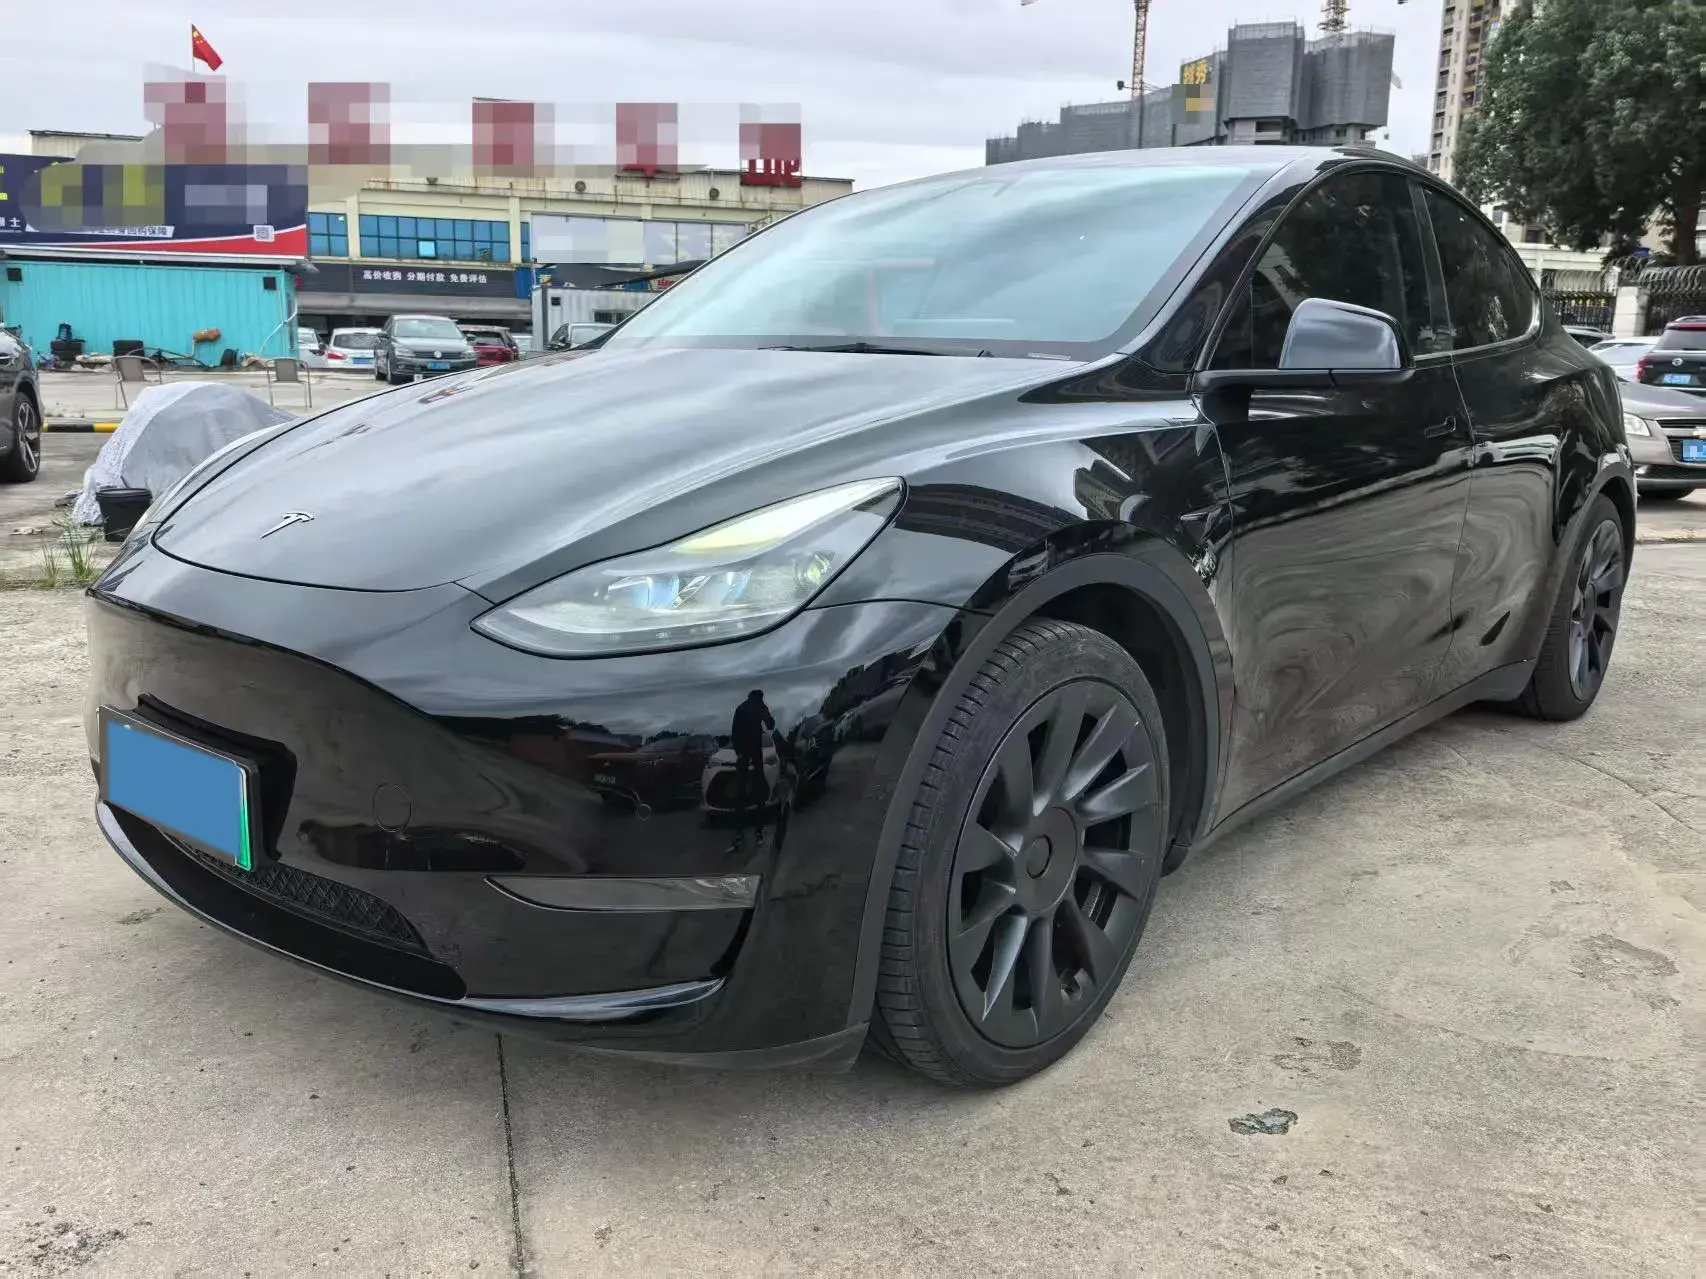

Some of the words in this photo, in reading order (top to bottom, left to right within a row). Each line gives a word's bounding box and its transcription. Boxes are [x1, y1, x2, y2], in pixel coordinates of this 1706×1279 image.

[363, 270, 402, 280] 高价收购
[406, 271, 445, 282] 分期付款
[449, 273, 488, 284] 免费评估
